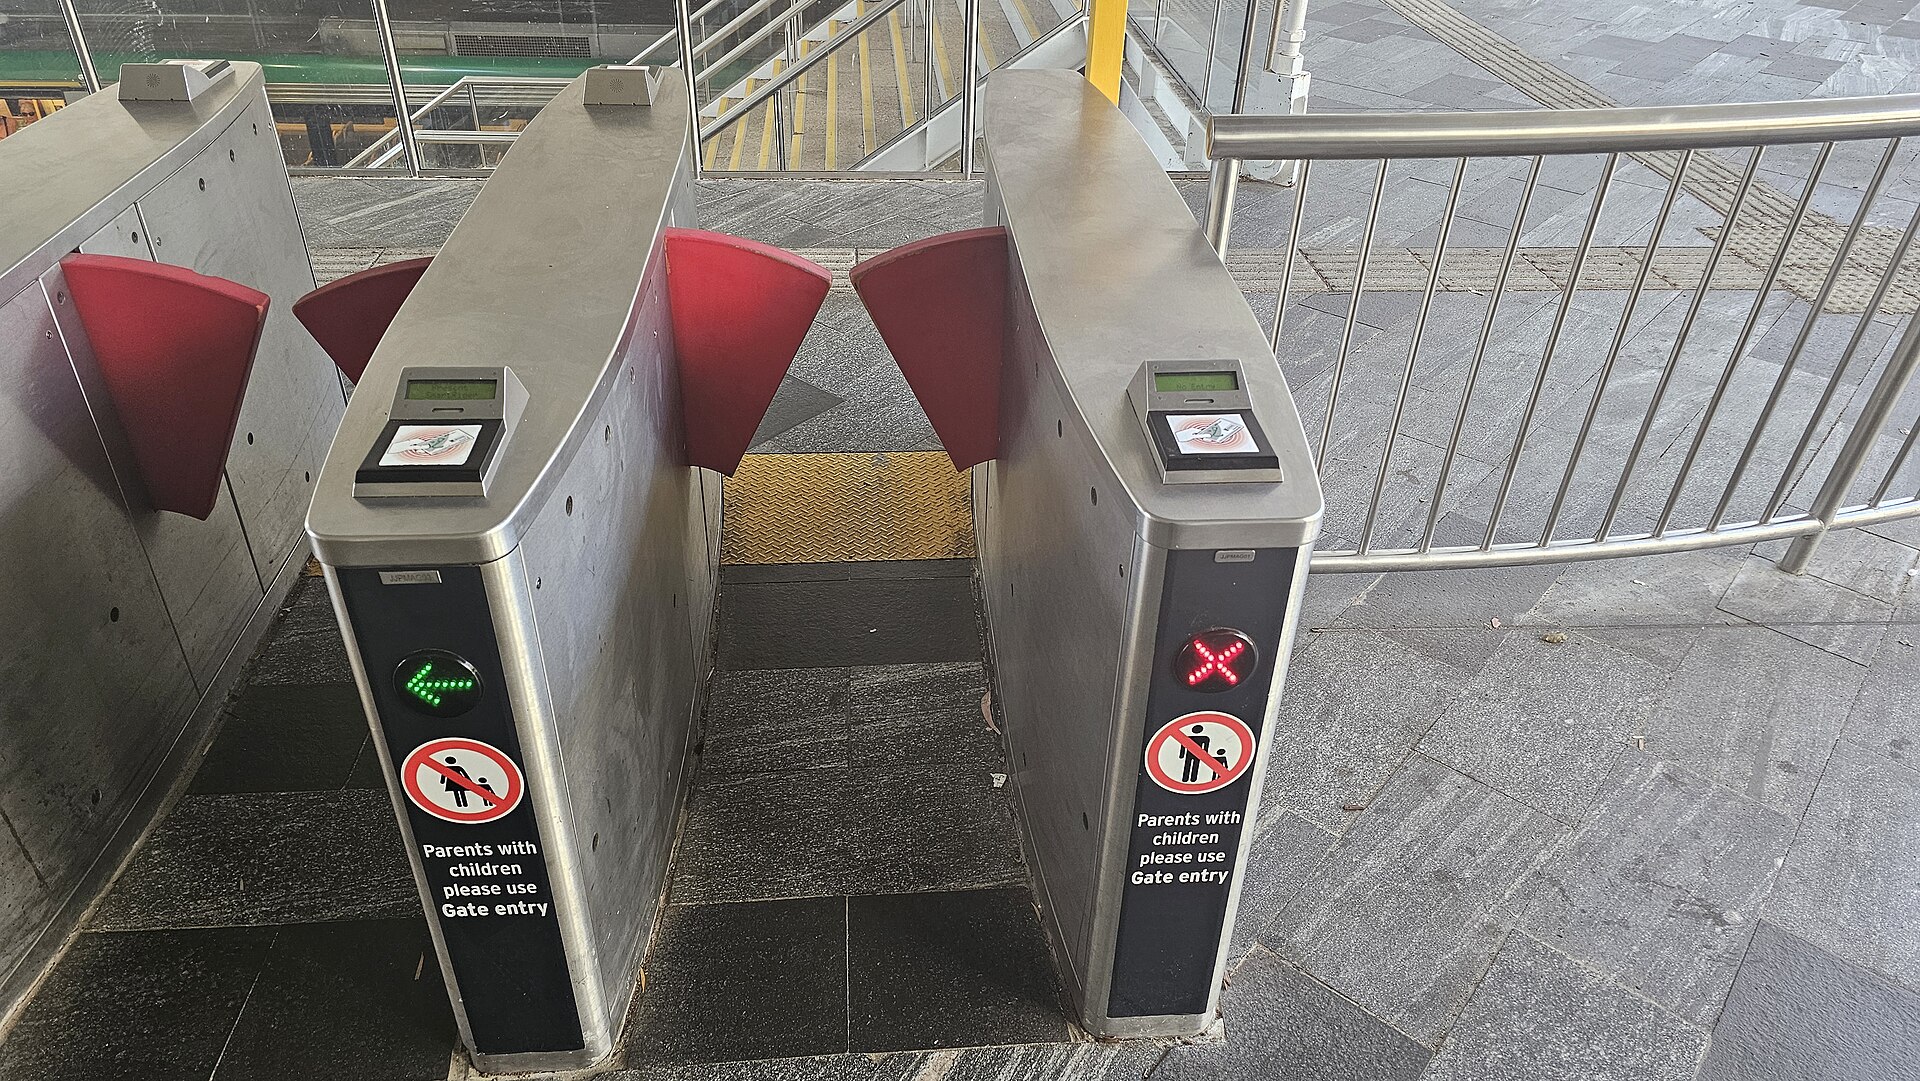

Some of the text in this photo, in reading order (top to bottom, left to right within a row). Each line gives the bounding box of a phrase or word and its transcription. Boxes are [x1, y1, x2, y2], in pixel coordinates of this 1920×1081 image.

[1138, 811, 1241, 827] Parents with
[1153, 832, 1219, 845] children
[423, 841, 537, 858] Parents with
[1140, 851, 1226, 867] please use
[449, 862, 522, 877] children
[1131, 869, 1229, 885] Gate entry
[443, 883, 537, 899] please use
[442, 901, 548, 917] Gate entry
